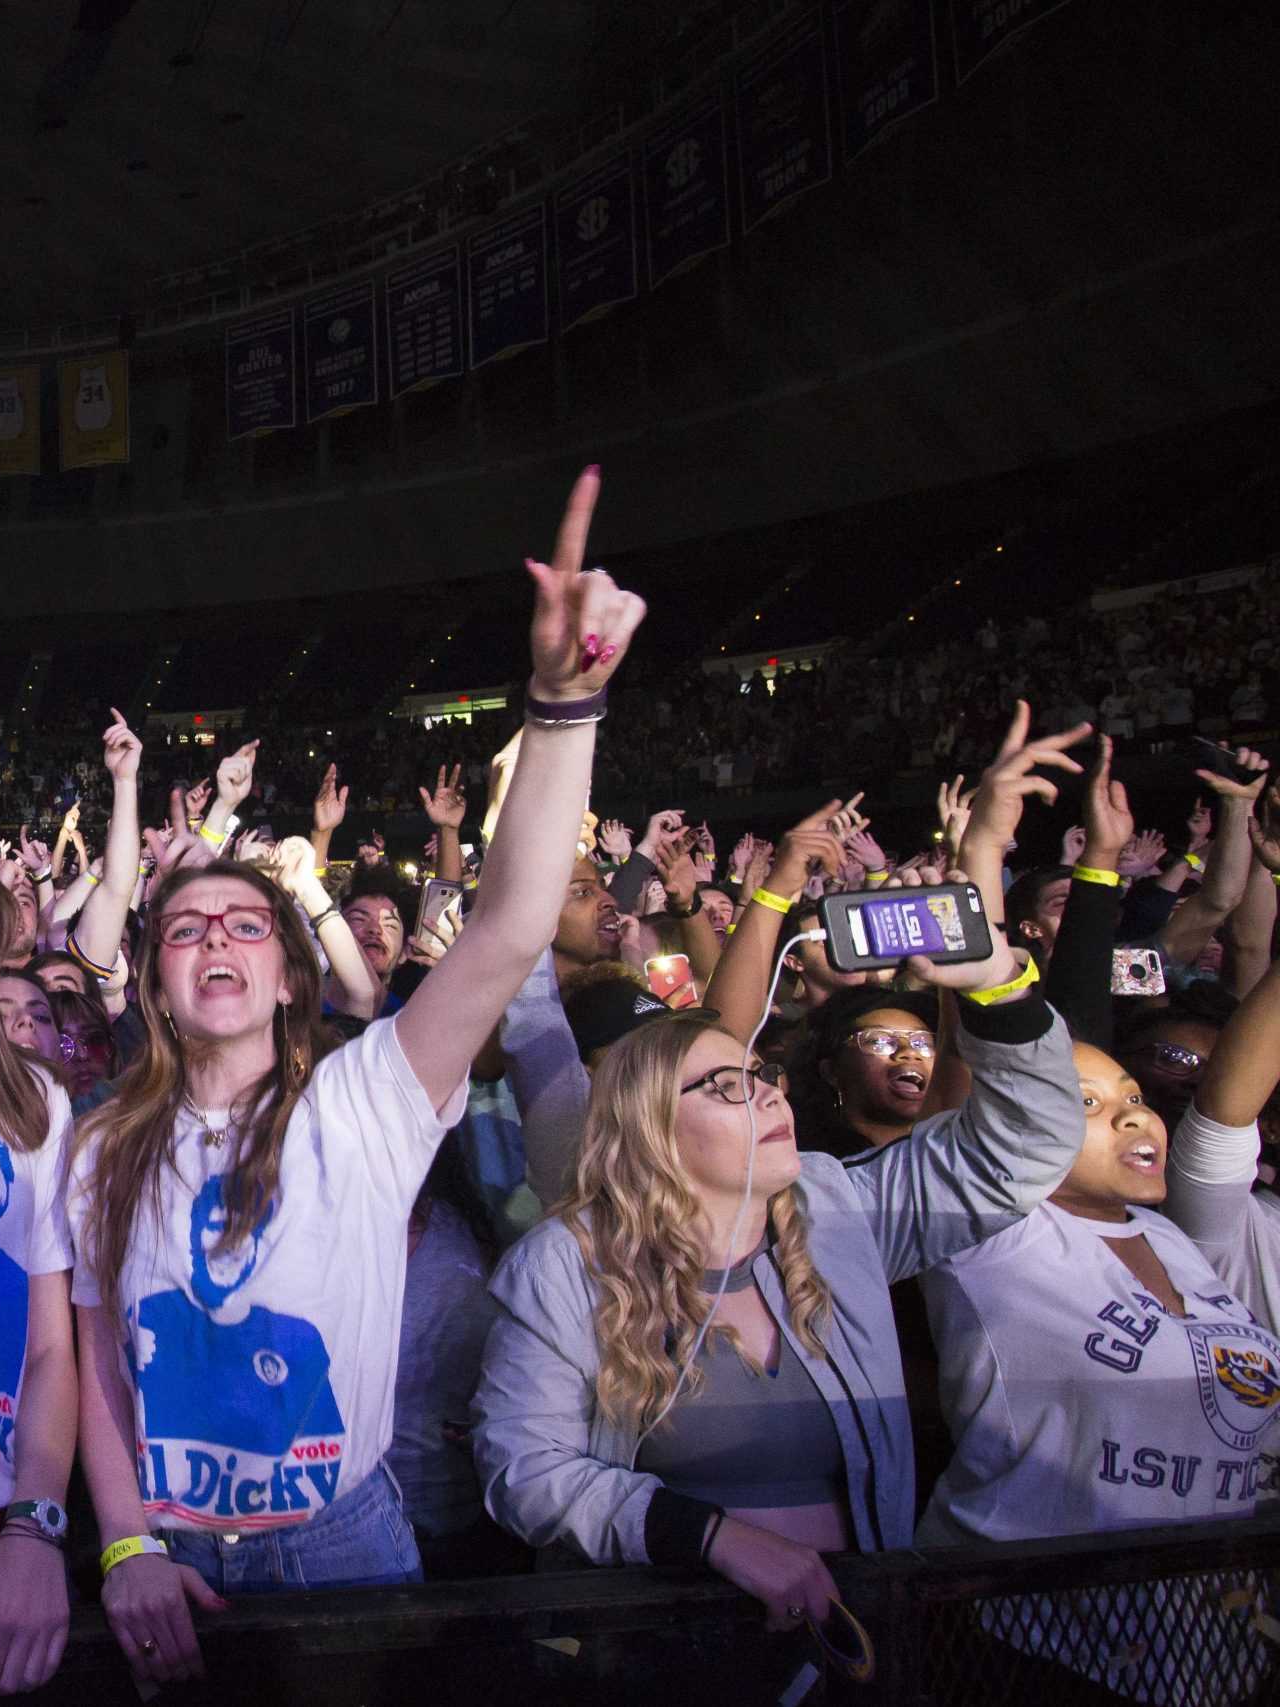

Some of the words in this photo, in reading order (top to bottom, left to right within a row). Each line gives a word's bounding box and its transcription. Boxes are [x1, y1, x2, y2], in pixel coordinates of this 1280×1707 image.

[901, 903, 925, 947] LSU
[291, 1442, 341, 1462] vote
[1098, 1438, 1203, 1499] LSU
[181, 1449, 342, 1517] Dicky
